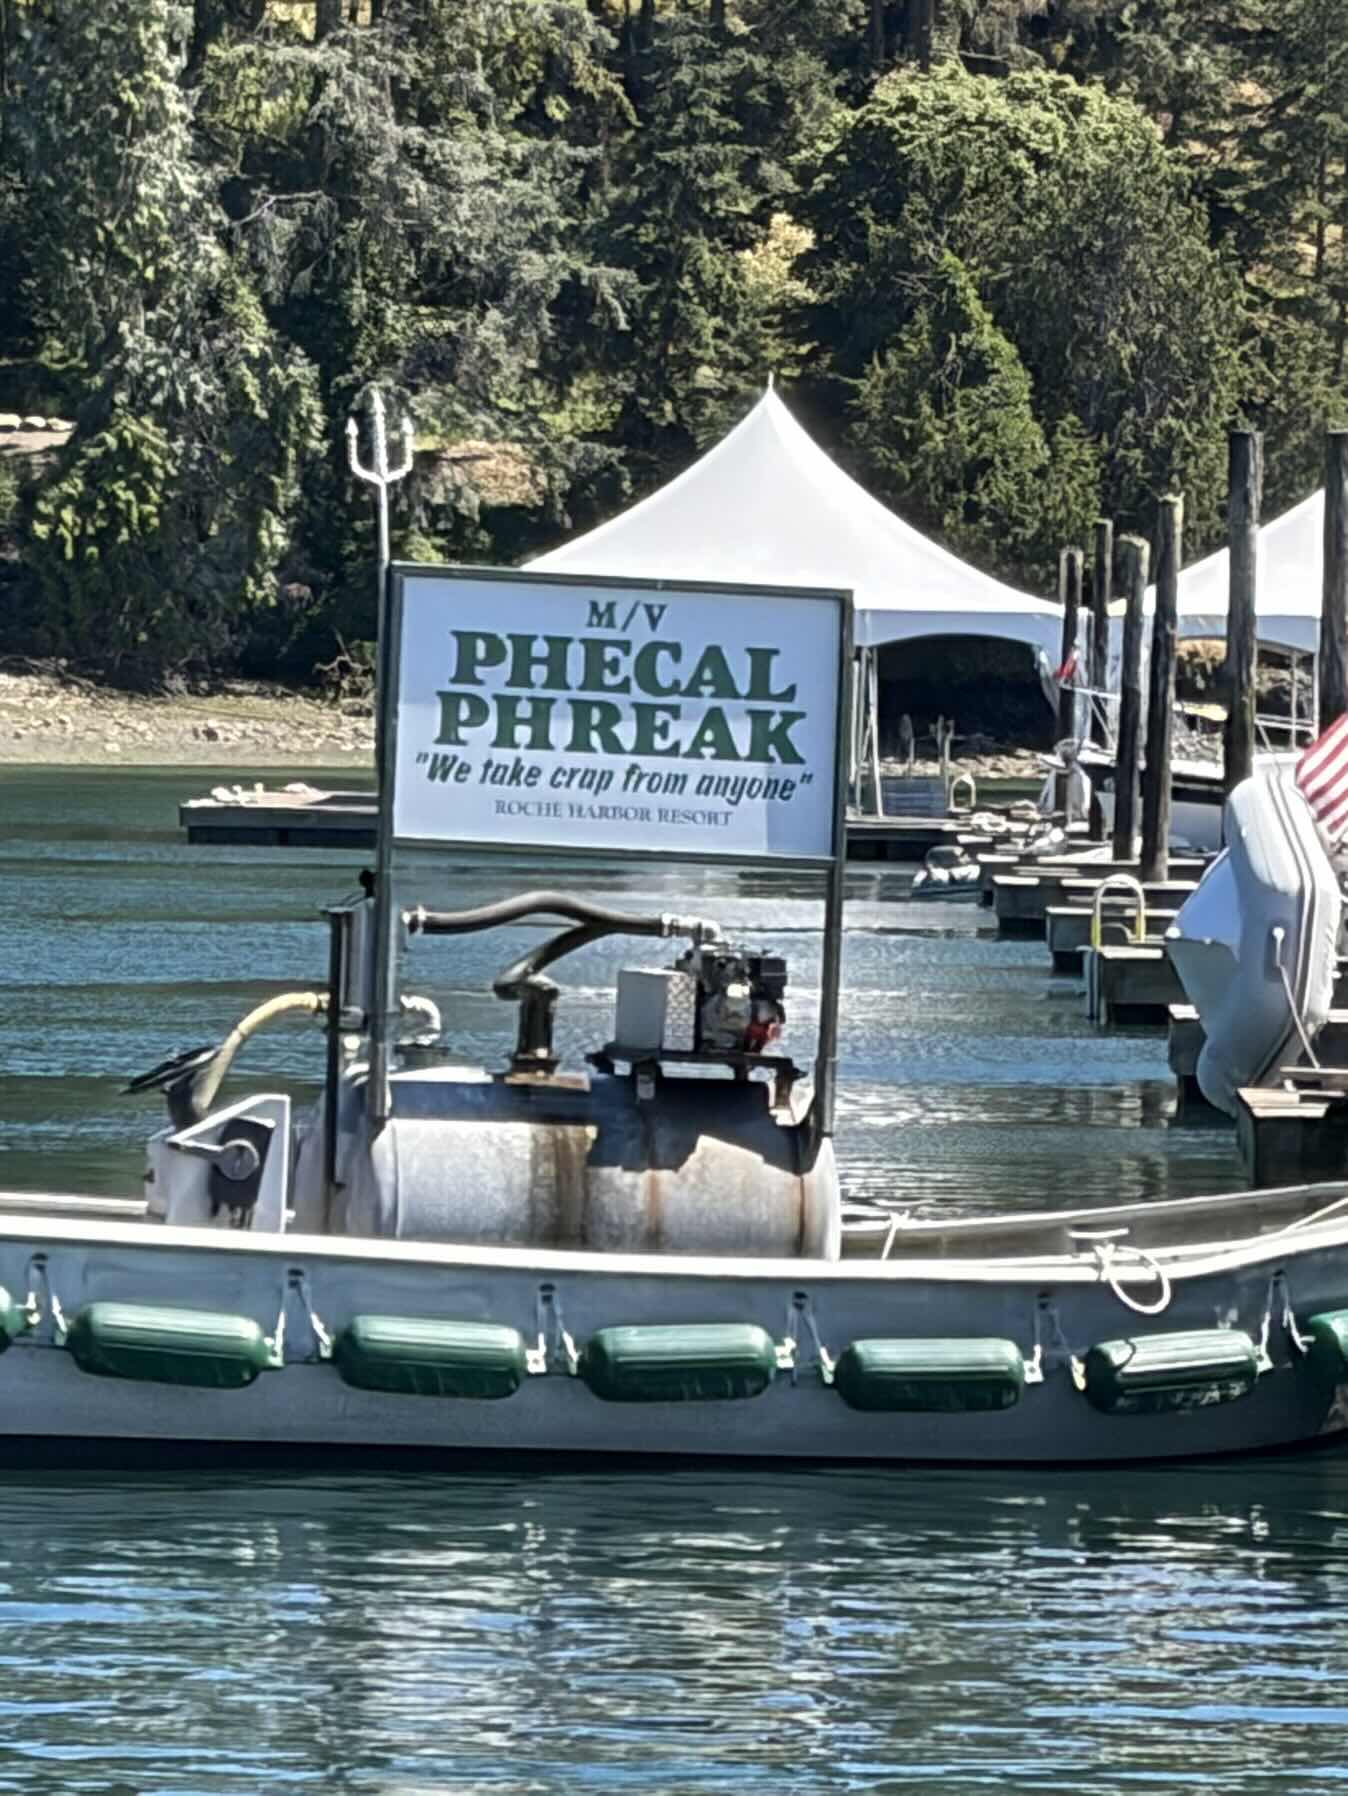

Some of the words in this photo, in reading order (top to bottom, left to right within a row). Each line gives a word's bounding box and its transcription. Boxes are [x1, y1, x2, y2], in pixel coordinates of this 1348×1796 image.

[587, 600, 668, 632] M/V
[450, 630, 797, 702] PHECAL
[434, 691, 808, 764] PHREAK
[415, 751, 472, 784] "We
[481, 758, 542, 788] take
[550, 766, 614, 796] crap
[622, 763, 686, 795] from
[695, 772, 814, 806] anyone"
[494, 799, 564, 819] ROCHE
[567, 803, 653, 823] HARBOR
[657, 808, 734, 827] RESORT
